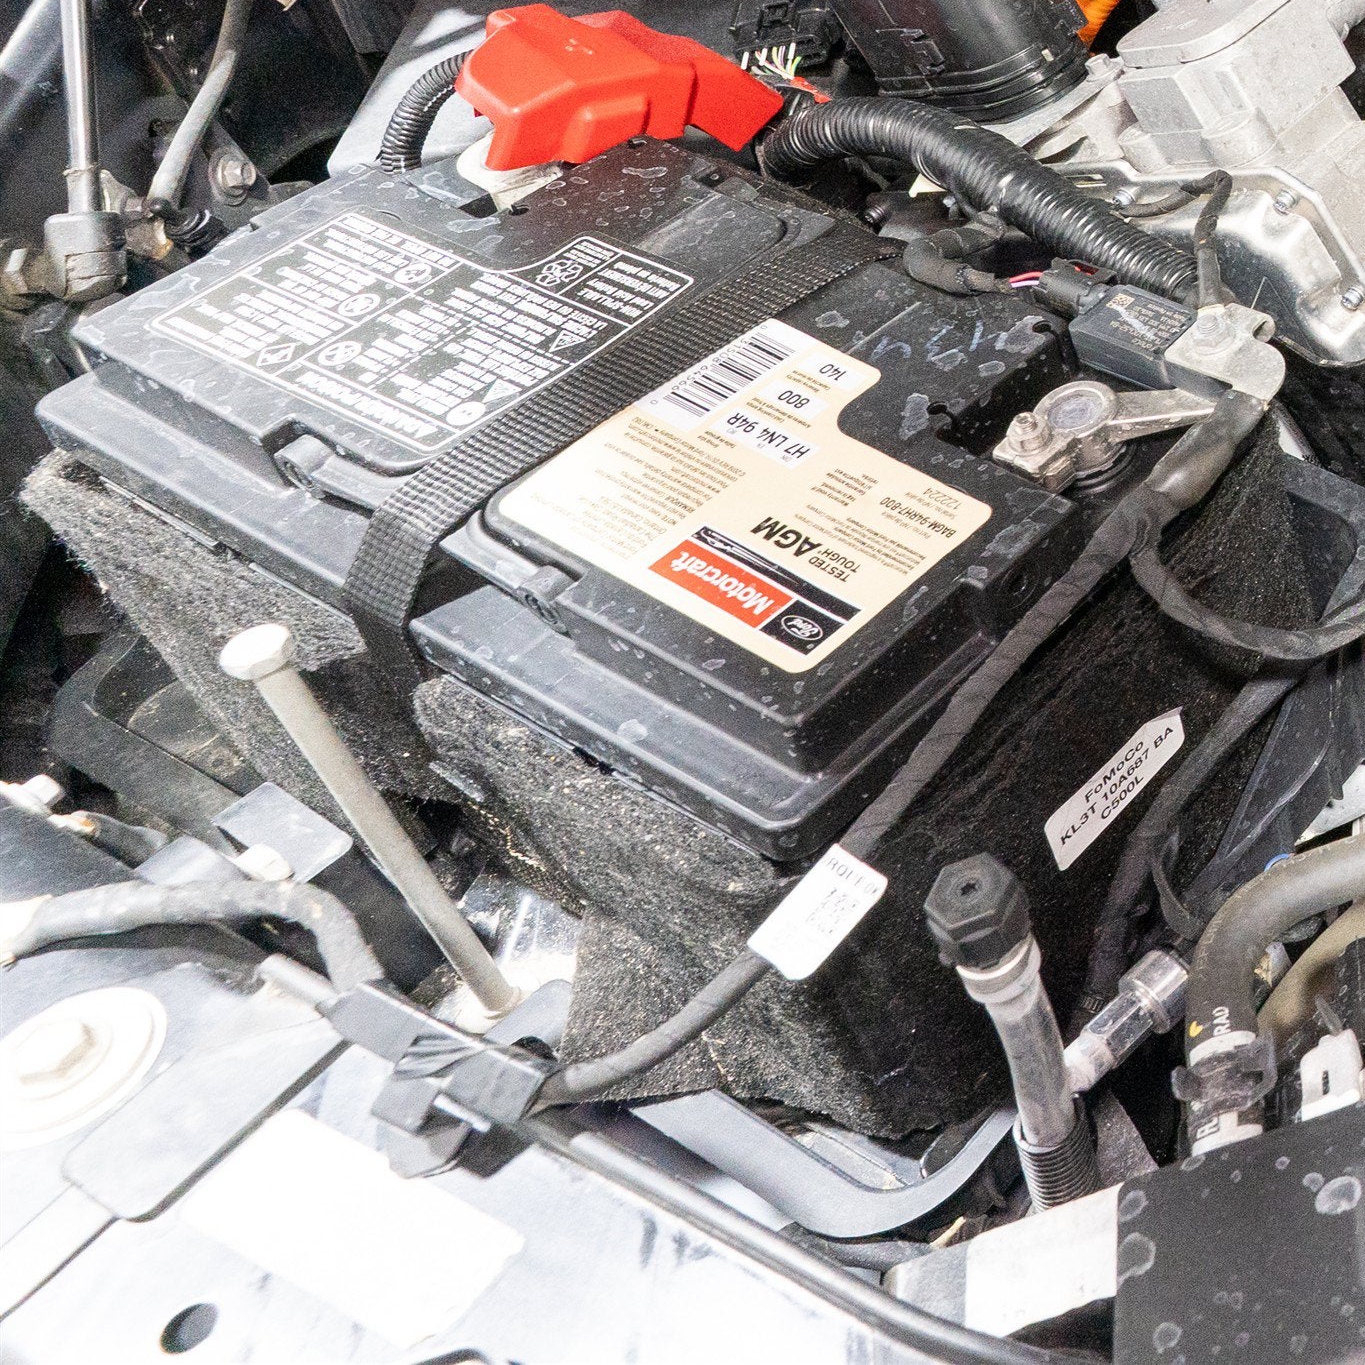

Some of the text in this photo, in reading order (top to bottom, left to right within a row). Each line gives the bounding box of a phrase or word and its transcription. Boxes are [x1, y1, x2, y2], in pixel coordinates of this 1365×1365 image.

[575, 287, 643, 317] NON-SPILLABLE
[710, 337, 749, 363] 31508
[670, 363, 710, 391] 64566
[816, 361, 849, 381] 140
[775, 388, 811, 410] 800
[724, 411, 811, 459] H7 LN4 94R
[921, 486, 965, 511] 122224
[877, 495, 957, 539] BAGM-94RH7-800
[749, 515, 823, 560] AGM
[665, 549, 777, 616] Motorcraft
[806, 554, 853, 581] TESTED
[782, 615, 820, 639] Ford
[1061, 726, 1174, 845] KL3T 10A687 BA
[1084, 740, 1143, 803] FoMoCo
[1101, 772, 1145, 820] C500L
[1212, 1006, 1232, 1037] RAD
